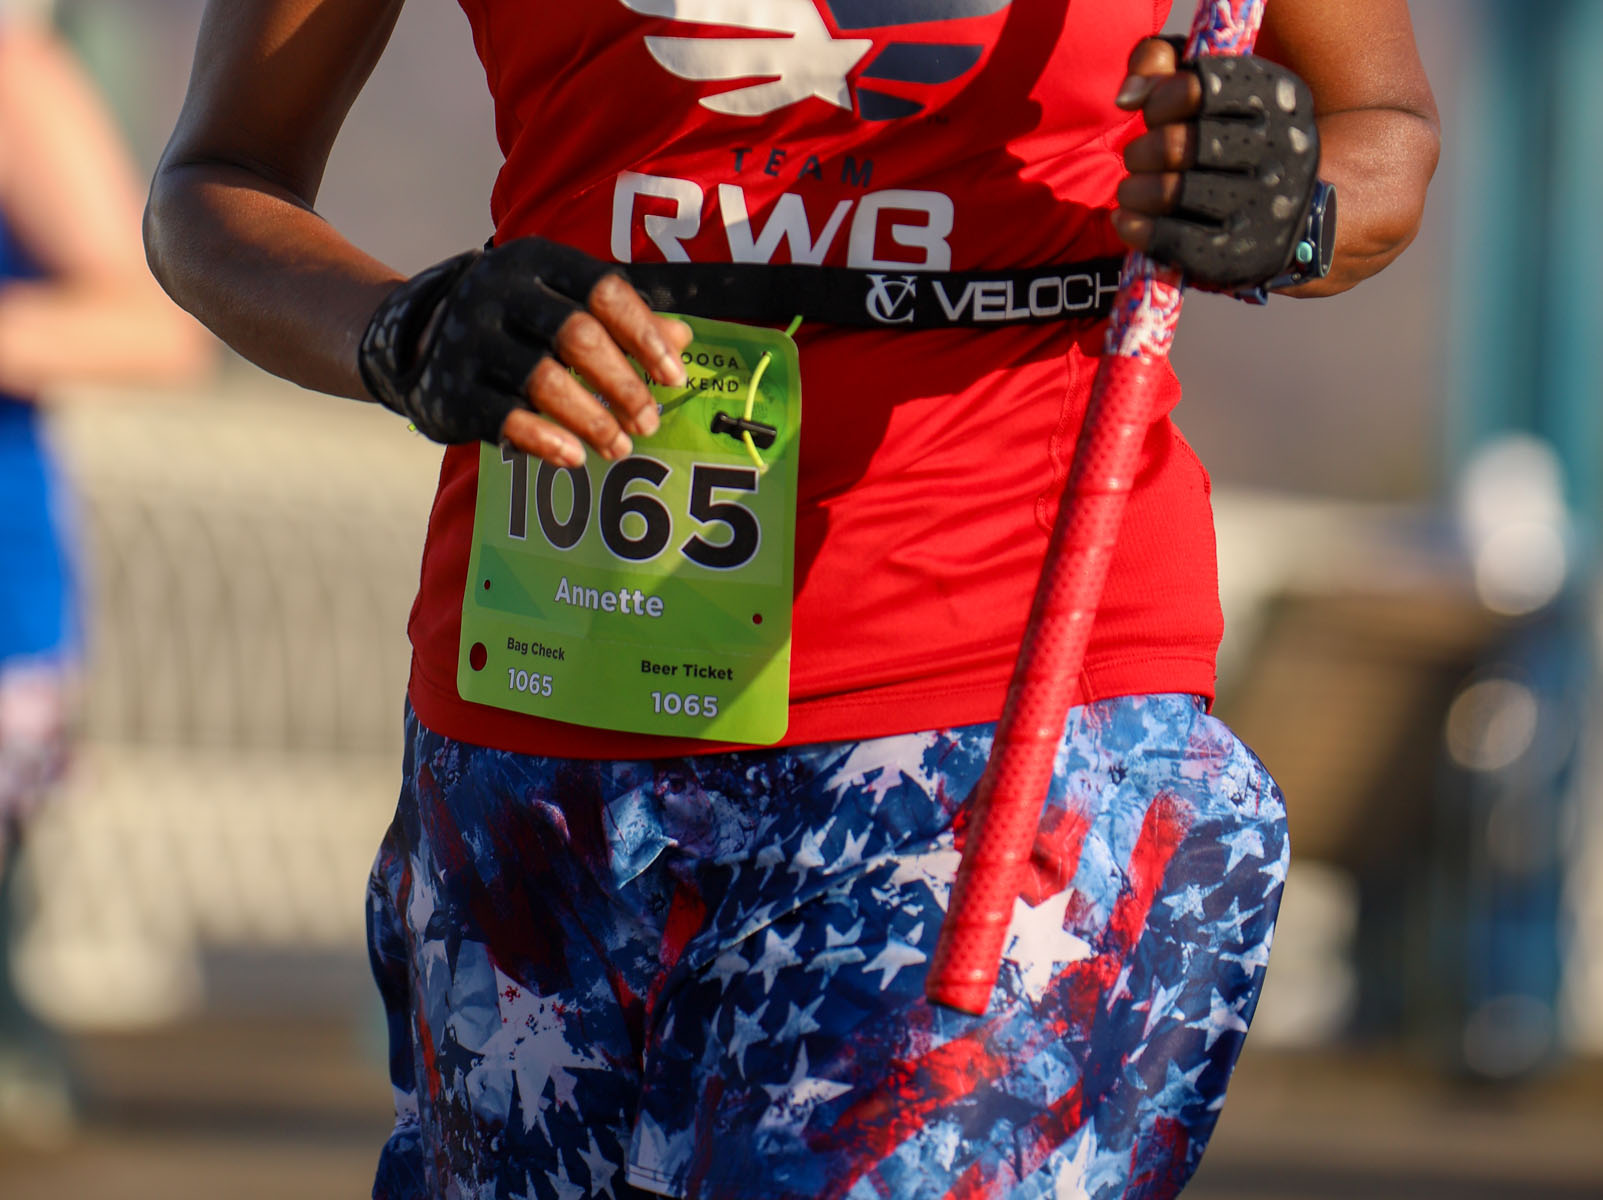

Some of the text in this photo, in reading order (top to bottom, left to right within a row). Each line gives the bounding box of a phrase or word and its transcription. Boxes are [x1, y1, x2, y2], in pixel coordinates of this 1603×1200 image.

[730, 147, 874, 188] TEAM
[611, 169, 954, 272] RWB
[644, 370, 739, 393] WKEND
[501, 447, 762, 571] 1065
[555, 577, 664, 618] Annette
[507, 637, 565, 661] Bag Check
[508, 667, 553, 697] 1065
[641, 660, 734, 680] Beer Ticket
[651, 691, 719, 718] 1065
